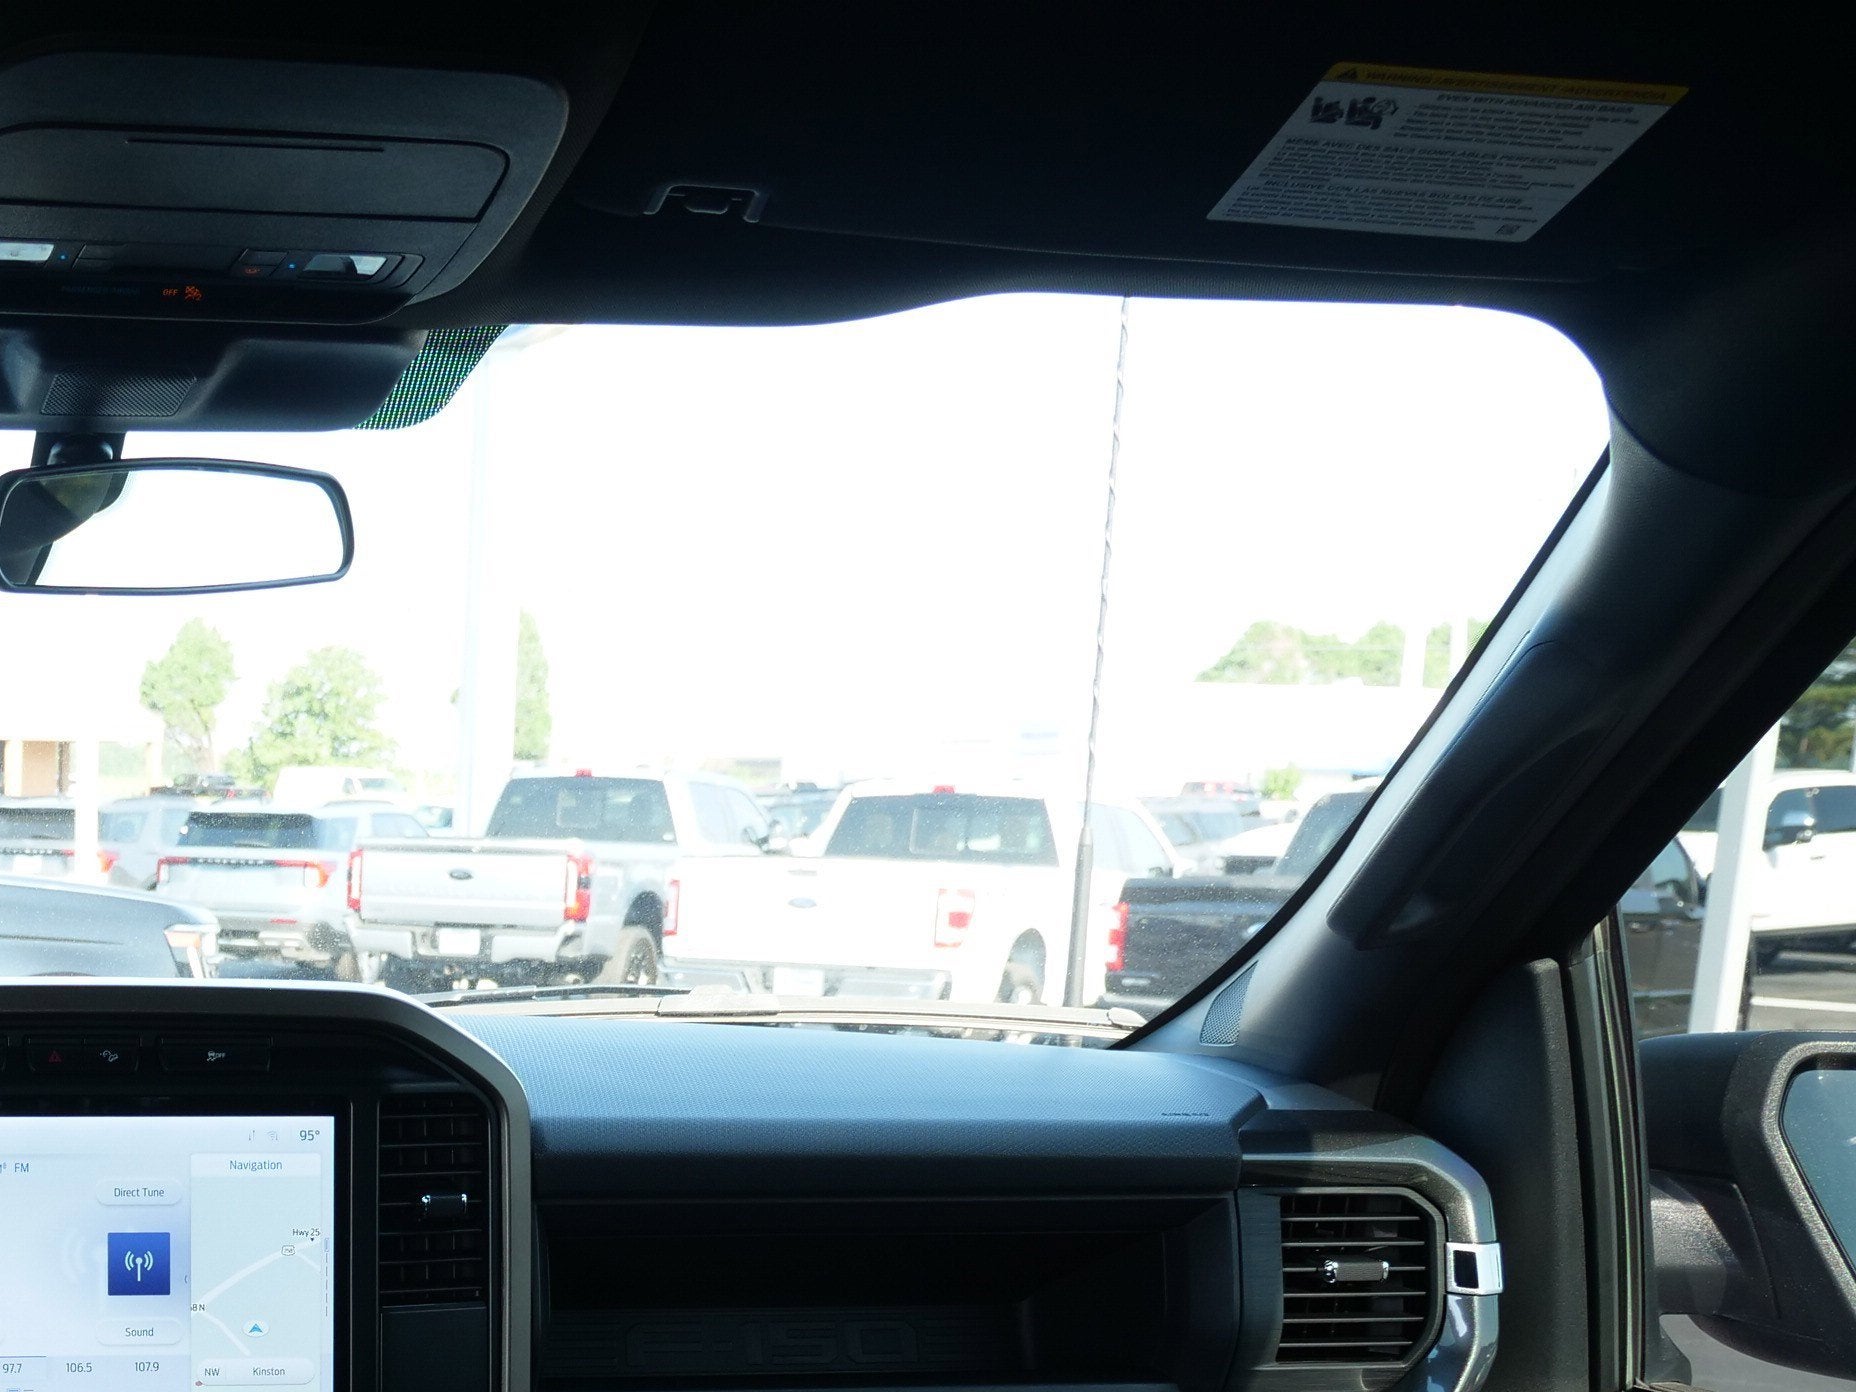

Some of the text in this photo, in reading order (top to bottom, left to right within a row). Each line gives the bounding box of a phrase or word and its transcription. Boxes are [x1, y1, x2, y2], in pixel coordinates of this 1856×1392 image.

[299, 1129, 320, 1141] 95°
[14, 1162, 30, 1173] FM
[229, 1159, 283, 1172] Navigation
[114, 1187, 165, 1198] Direct Tune
[292, 1228, 321, 1238] Hwy 25
[199, 1303, 206, 1312] N
[125, 1326, 154, 1337] Sound
[624, 1320, 919, 1368] F-150
[2, 1362, 23, 1374] 97.7
[65, 1362, 92, 1373] 106.5
[134, 1361, 159, 1372] 107.9
[204, 1367, 220, 1377] NW
[252, 1366, 285, 1376] Kinston
